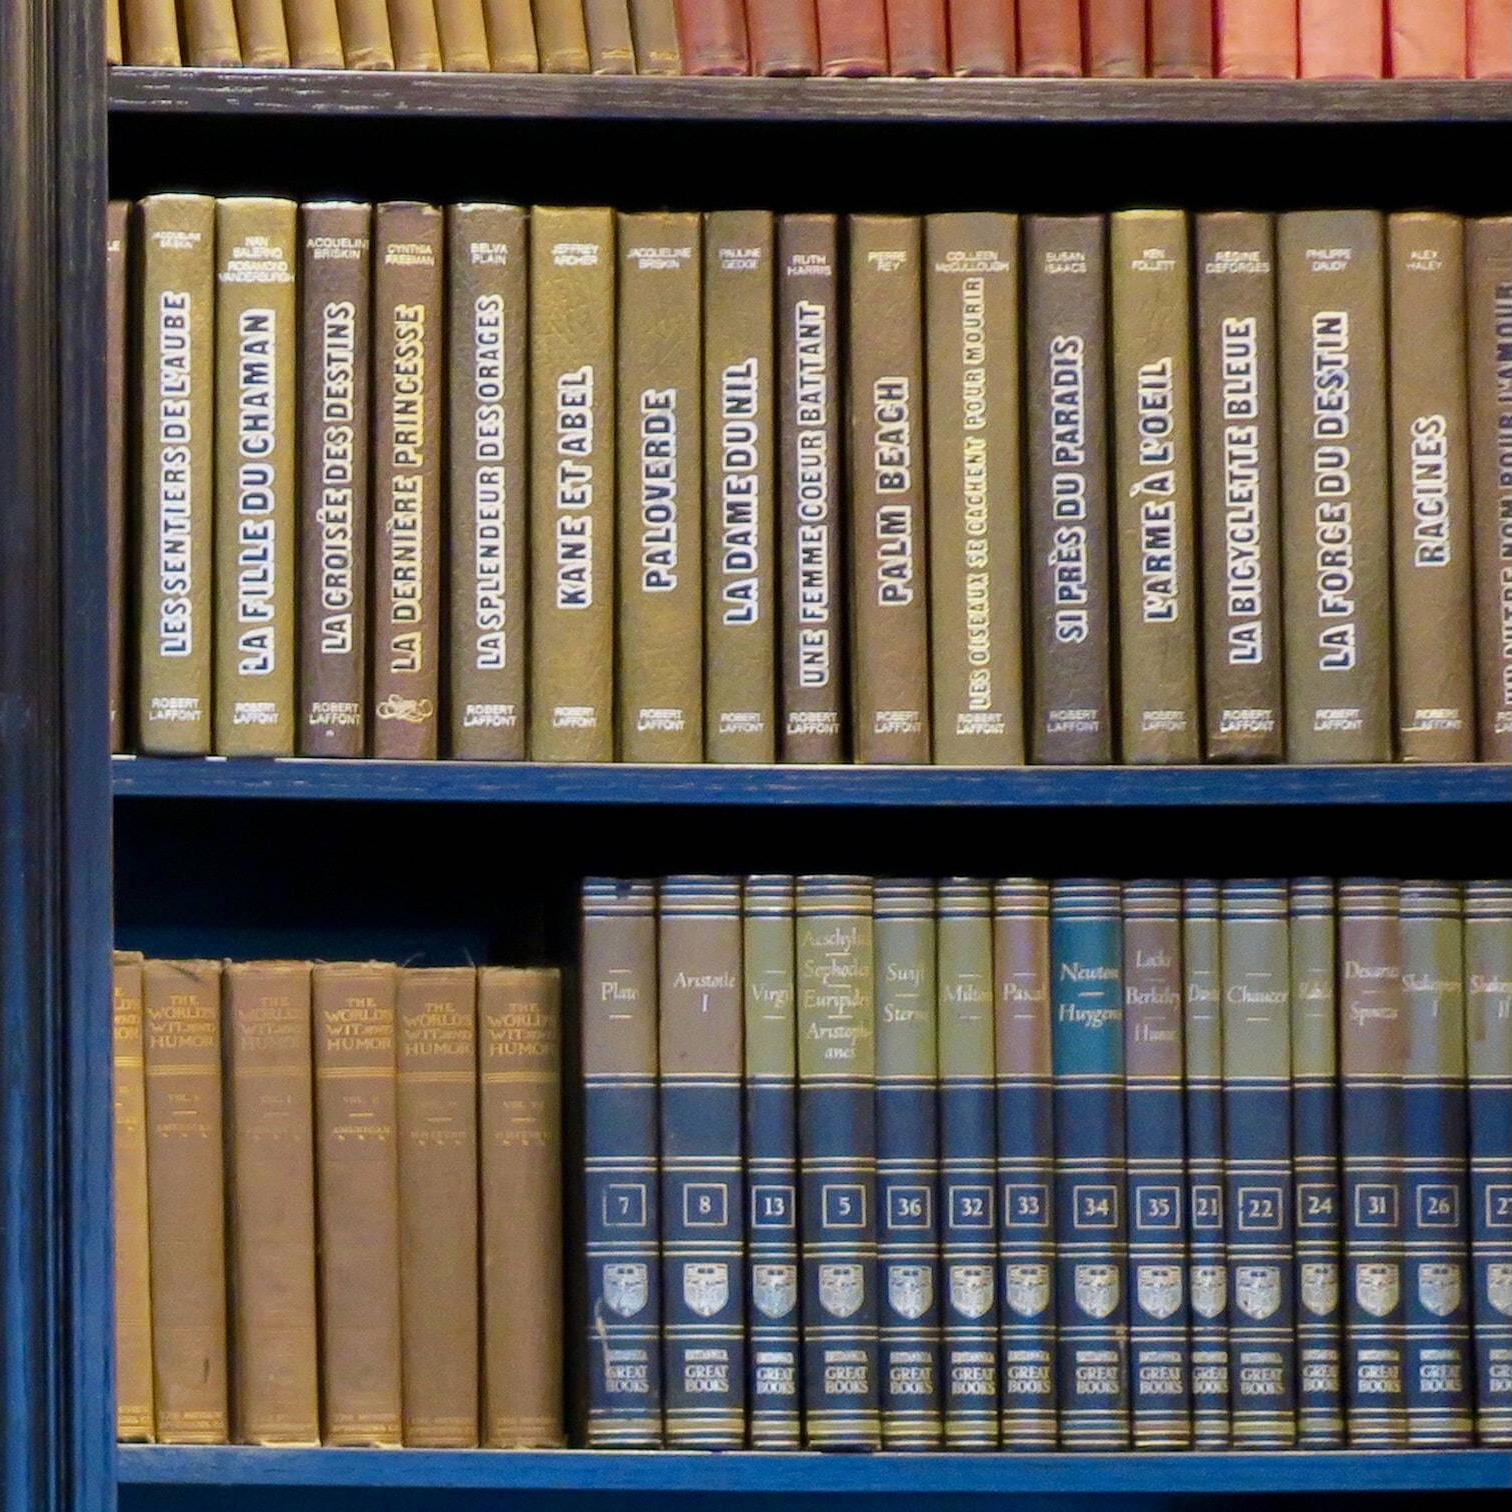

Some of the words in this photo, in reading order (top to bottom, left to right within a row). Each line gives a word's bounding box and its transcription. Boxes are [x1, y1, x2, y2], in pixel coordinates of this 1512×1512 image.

[788, 265, 831, 276] HARRIS
[793, 254, 826, 265] RUTH
[160, 290, 190, 396] L'AUBE
[240, 308, 276, 458] CHAMAN
[723, 357, 757, 418] NIL
[162, 400, 190, 443] DE
[558, 366, 593, 456] ABEL
[875, 376, 910, 493] BEACH
[1139, 357, 1173, 466] L'OEIL
[723, 421, 758, 472] DU
[240, 463, 274, 515] DU
[558, 465, 592, 509] ET
[642, 389, 677, 592] PALOVERDE
[1130, 471, 1175, 498] À
[1412, 414, 1450, 567] RACINES
[162, 445, 191, 595] SENTIERS
[723, 474, 758, 574] DAME
[240, 519, 274, 623] FILLE
[557, 515, 592, 609] KANE
[878, 505, 912, 606] PALM
[1144, 501, 1178, 623] L'ARME
[162, 597, 191, 656] LES
[724, 578, 758, 625] LA
[240, 627, 273, 676] LA
[463, 716, 516, 727] LAFFONT
[466, 704, 514, 716] ROBERT
[618, 1197, 629, 1215] 7
[698, 1196, 712, 1214] 8
[838, 1196, 851, 1216] 5
[897, 1196, 922, 1218] 36
[1084, 1196, 1109, 1218] 34
[1148, 1196, 1171, 1218] 35
[824, 1366, 869, 1380] GREAT
[824, 1379, 869, 1395] BOOKS
